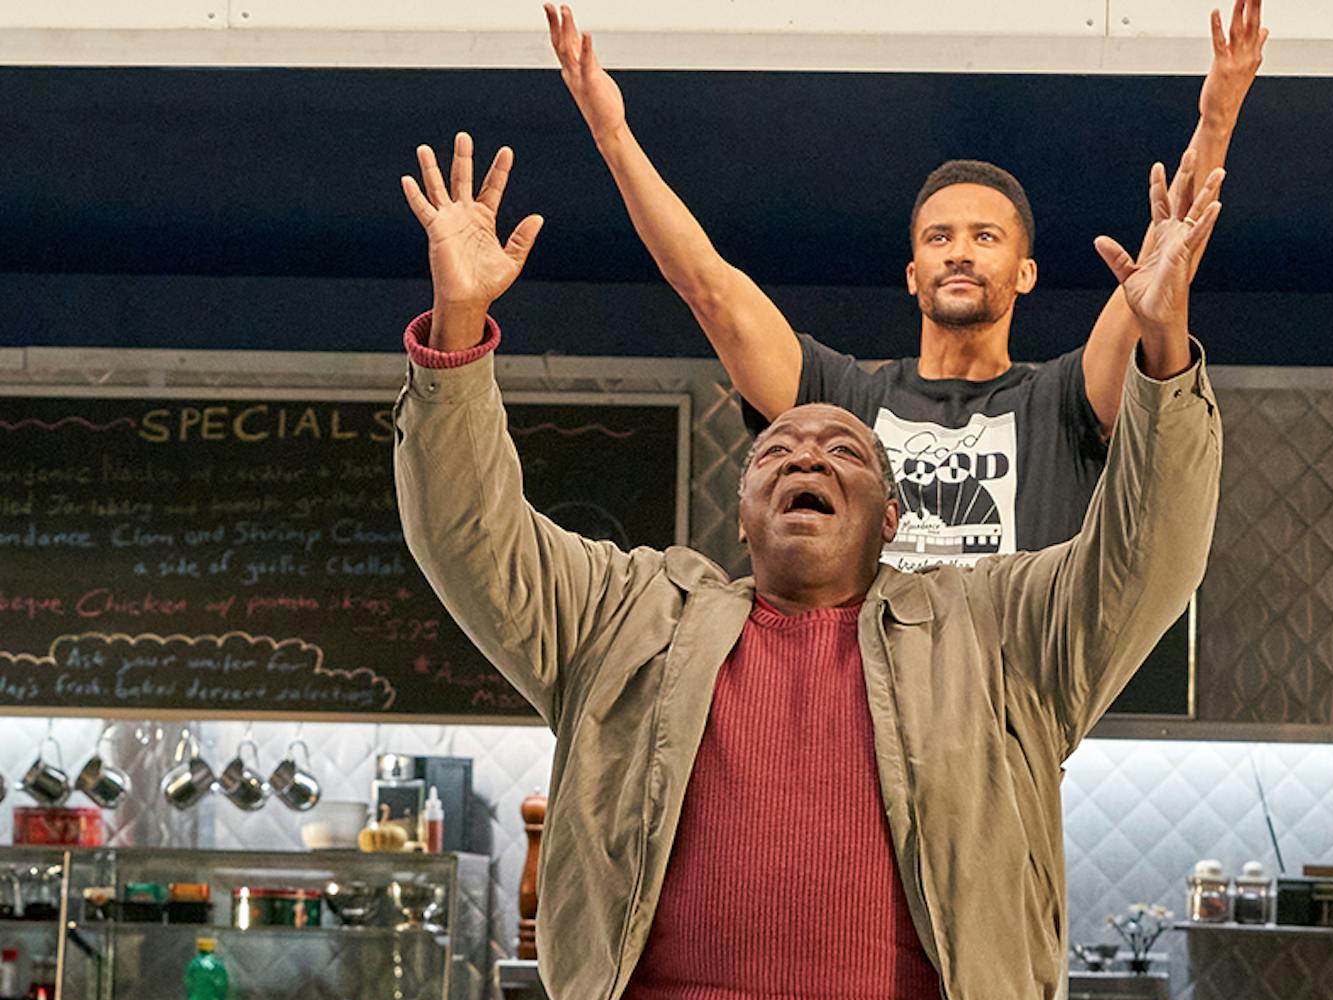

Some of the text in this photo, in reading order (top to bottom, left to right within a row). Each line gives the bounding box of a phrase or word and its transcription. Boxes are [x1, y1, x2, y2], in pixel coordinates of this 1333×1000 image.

[139, 404, 396, 443] SPECIALS
[900, 451, 1010, 485] OOD
[0, 523, 96, 547] ondance
[112, 522, 174, 547] Clam
[231, 520, 323, 552] Shrimp
[159, 556, 201, 578] side
[207, 549, 235, 575] of
[0, 589, 65, 621] beque
[75, 588, 188, 618] Chicken
[66, 646, 105, 669] Ask
[0, 676, 39, 700] ay's
